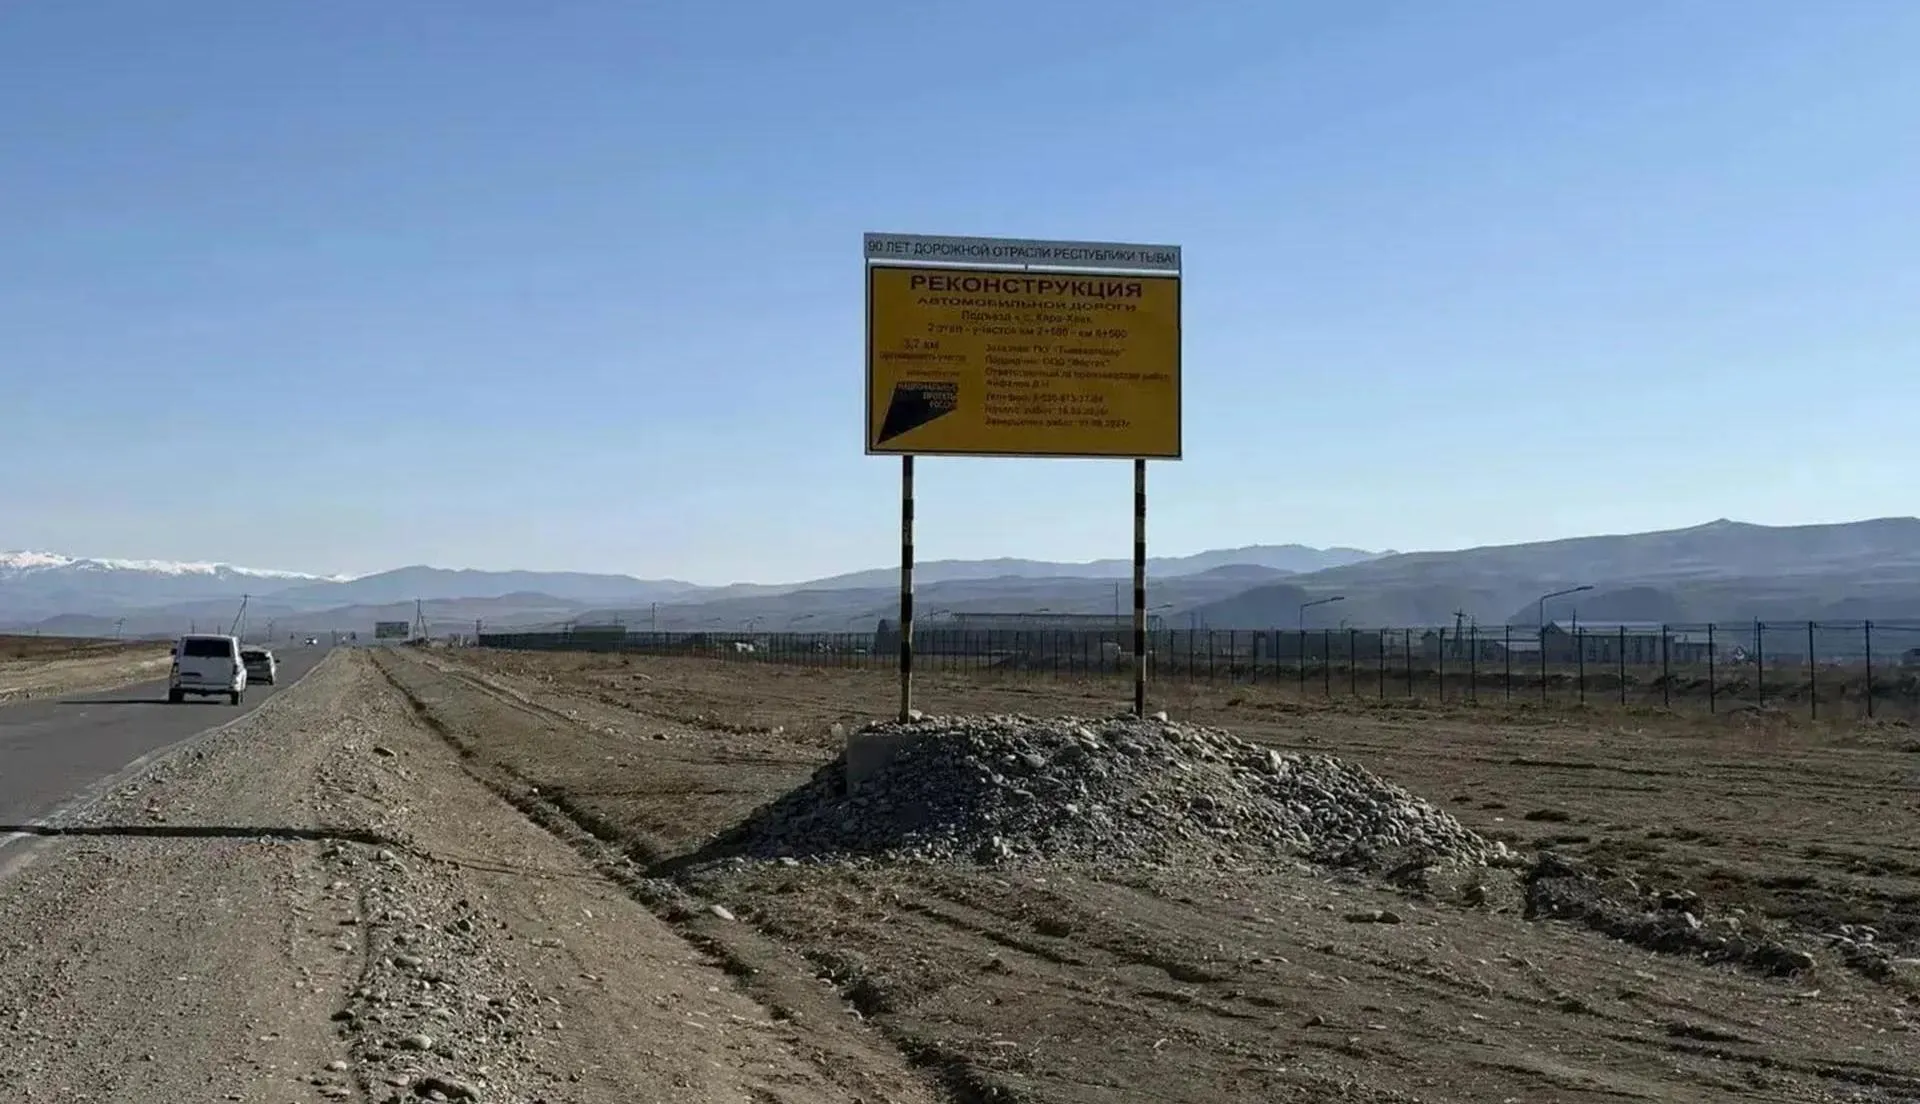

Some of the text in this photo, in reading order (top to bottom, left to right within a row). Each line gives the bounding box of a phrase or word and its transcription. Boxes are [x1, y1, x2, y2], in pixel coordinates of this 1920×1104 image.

[868, 240, 1176, 263] 90 ЛЕТ ДОРОЖНОЙ ОТРАСЛИ РЕСПУБЛИКИ ТЫВА!
[910, 275, 1142, 300] РЕКОНСТРУКЦИЯ
[917, 297, 1137, 312] АВТОМОБИЛЬНОЙ ДОРОГИ
